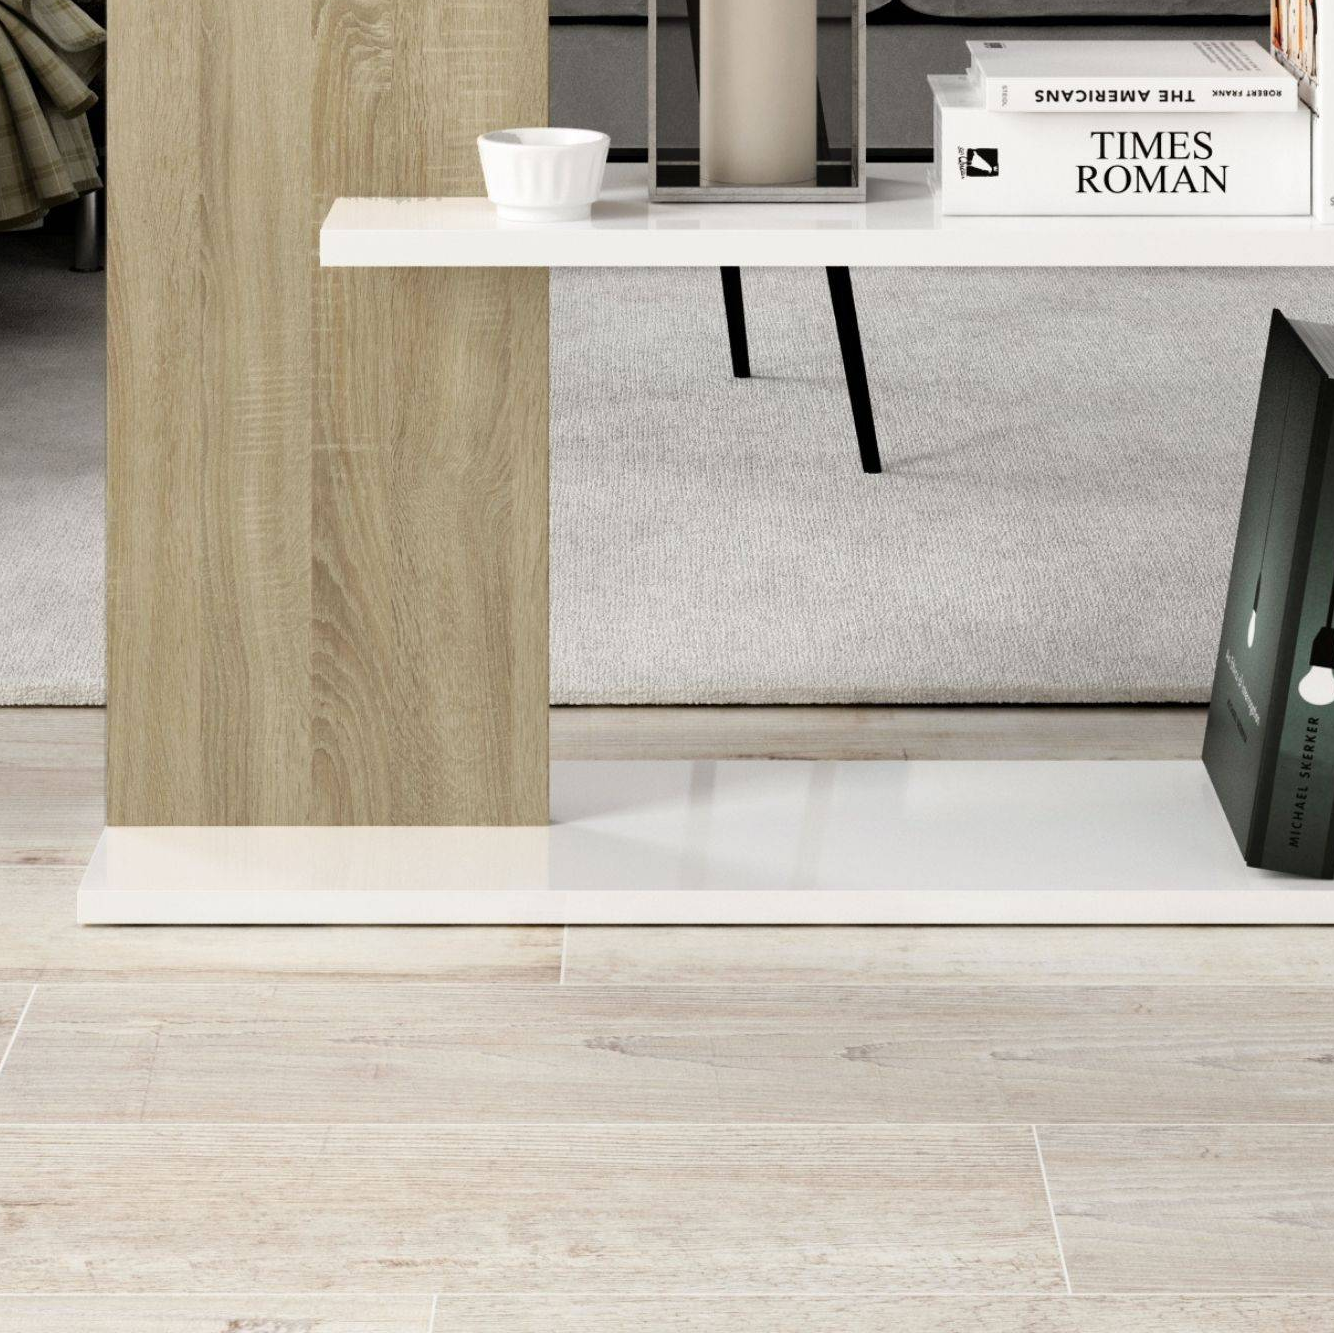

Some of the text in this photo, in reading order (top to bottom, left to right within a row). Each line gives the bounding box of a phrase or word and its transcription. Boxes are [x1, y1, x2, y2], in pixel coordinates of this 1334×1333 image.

[1034, 89, 1196, 103] THE AMERICANS
[1211, 89, 1283, 98] ROBERT FRANK
[1090, 130, 1213, 161] TIMES
[1075, 164, 1229, 194] ROMAN
[1289, 716, 1320, 849] MICHAEL SKERKER
